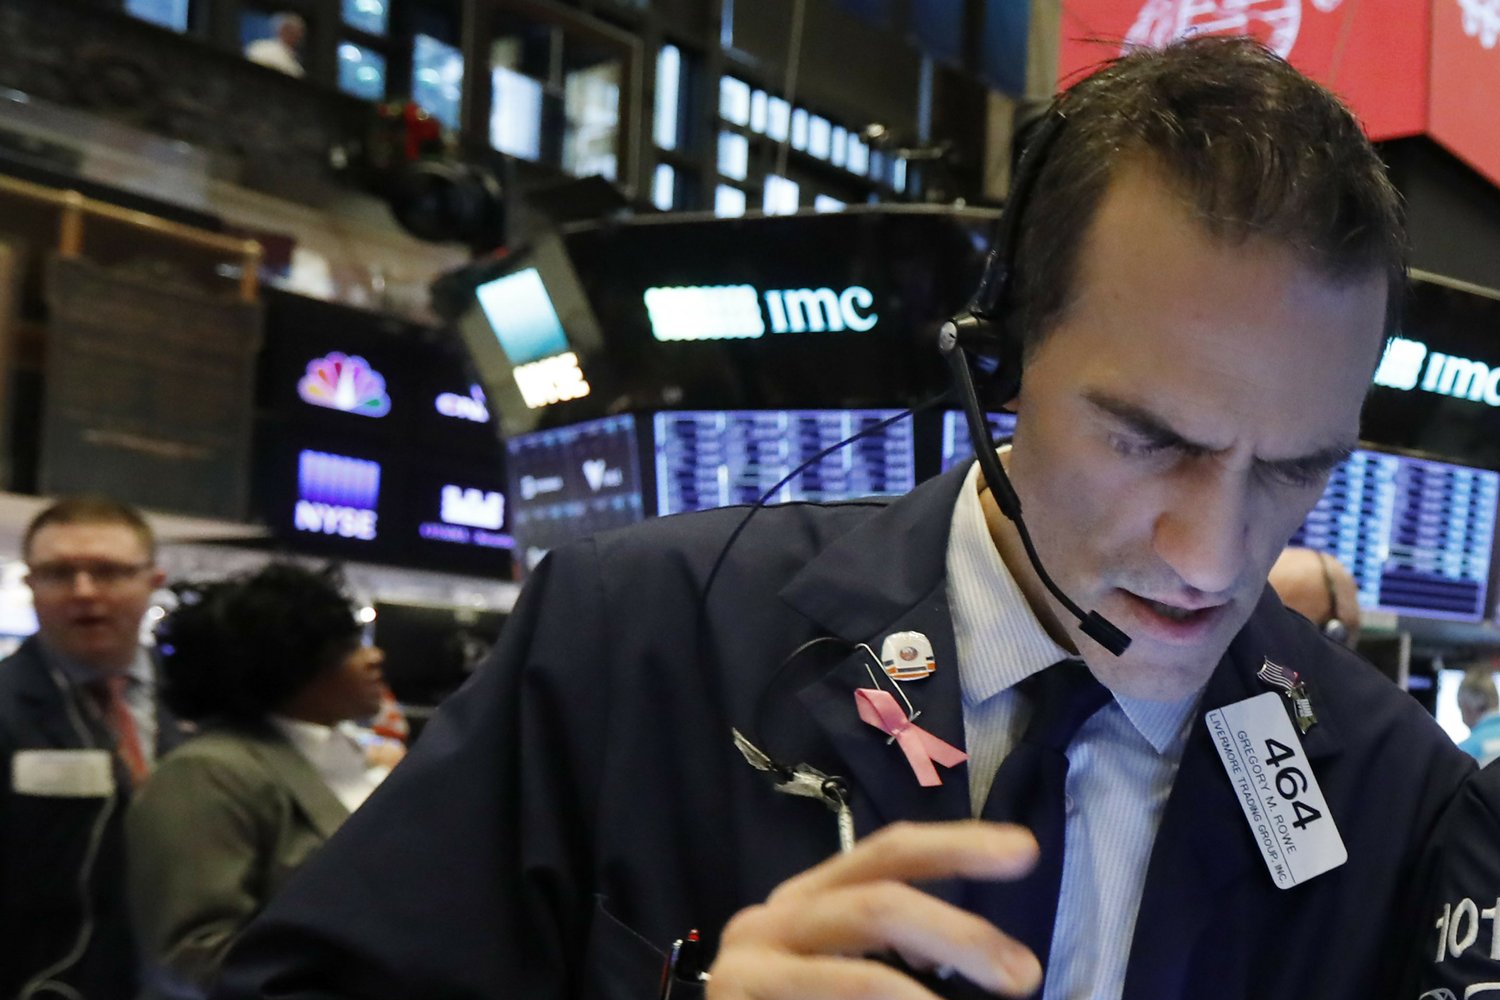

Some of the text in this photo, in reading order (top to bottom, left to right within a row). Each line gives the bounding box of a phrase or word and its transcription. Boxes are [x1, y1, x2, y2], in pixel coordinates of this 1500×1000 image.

[295, 499, 378, 540] NYSE
[1209, 712, 1242, 775] LIVERMORE
[1238, 778, 1262, 822] TRADING
[1237, 730, 1297, 855] GREGORY M. ROWE
[1264, 738, 1322, 830] 464
